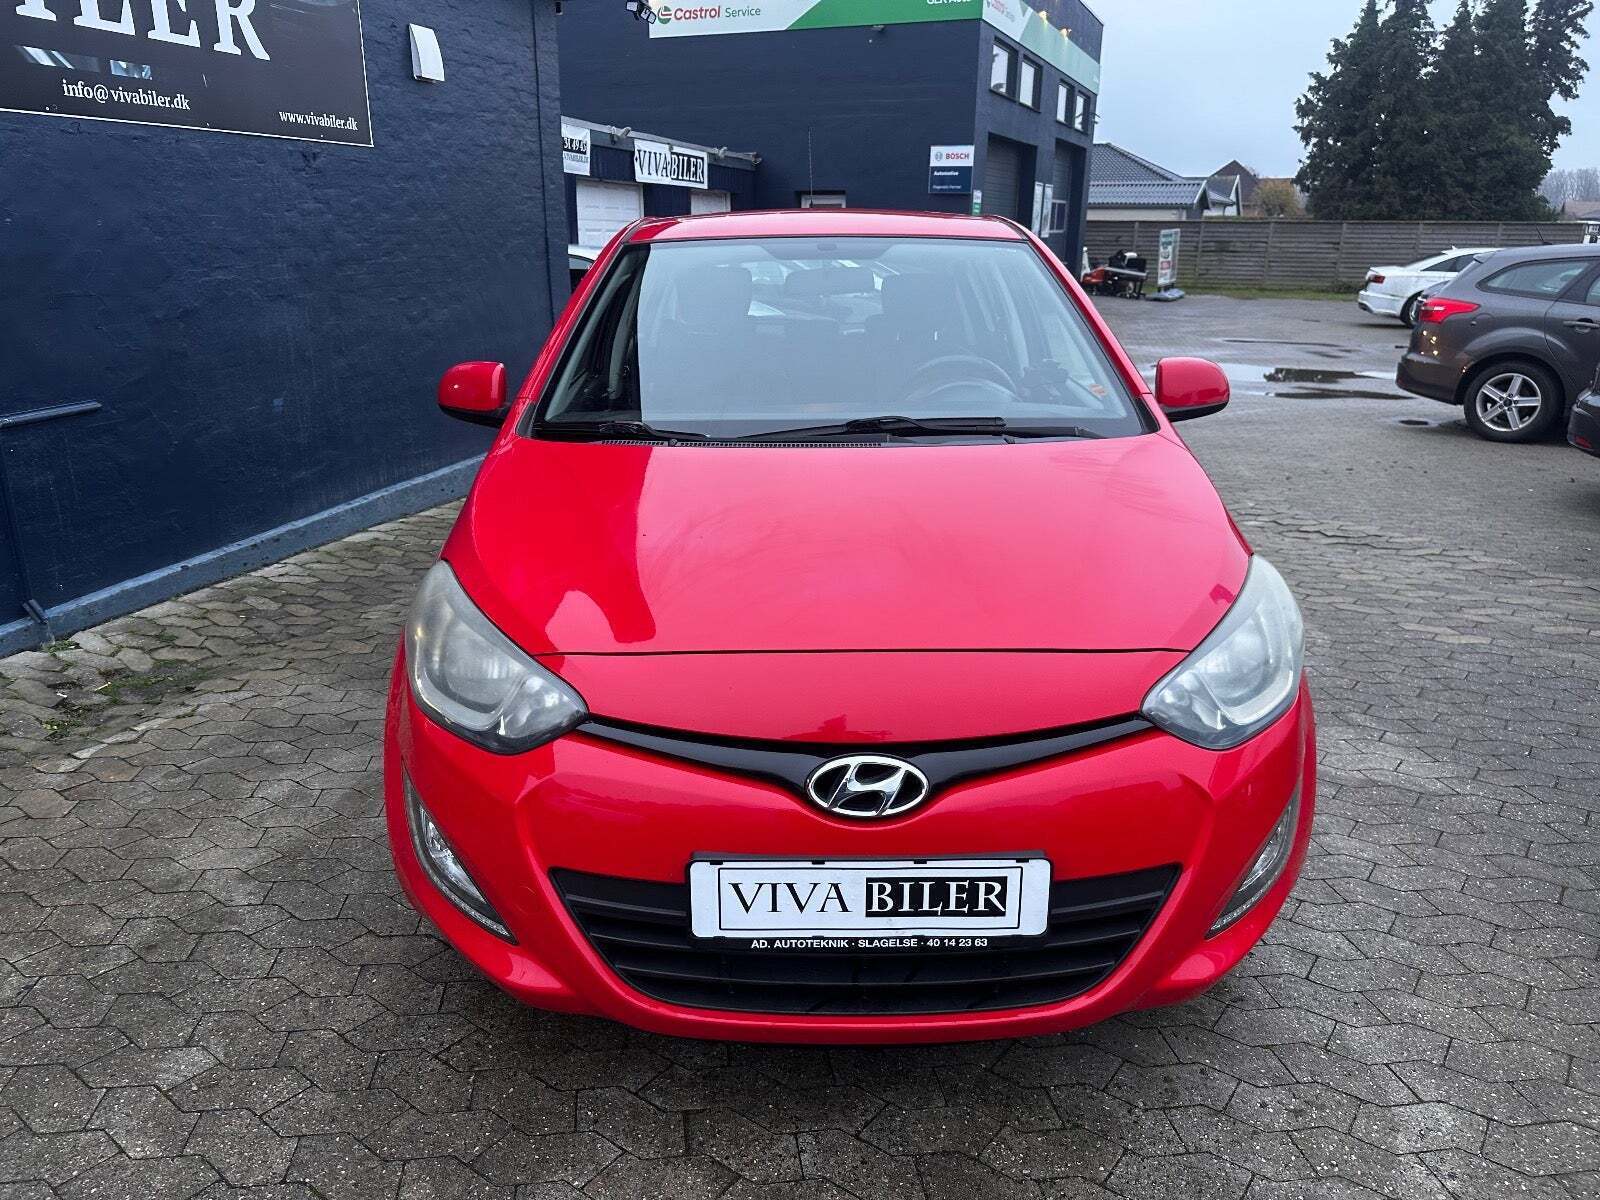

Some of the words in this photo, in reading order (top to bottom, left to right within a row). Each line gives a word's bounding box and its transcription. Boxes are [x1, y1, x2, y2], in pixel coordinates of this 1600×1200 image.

[674, 5, 721, 20] Castrol
[725, 6, 761, 17] Service
[16, 0, 272, 60] ER
[279, 111, 358, 130] www.vivabiler.dk
[945, 152, 970, 160] BOSCH
[671, 154, 705, 182] BILER
[728, 881, 853, 914] VIVA
[866, 880, 1006, 916] BILER
[751, 939, 770, 948] AD.
[774, 939, 849, 948] AUTOTEKNIK
[858, 938, 918, 948] SLAGELSE
[926, 938, 940, 947] 40
[943, 938, 956, 947] 14
[958, 938, 972, 947] 23
[974, 938, 988, 947] 63
